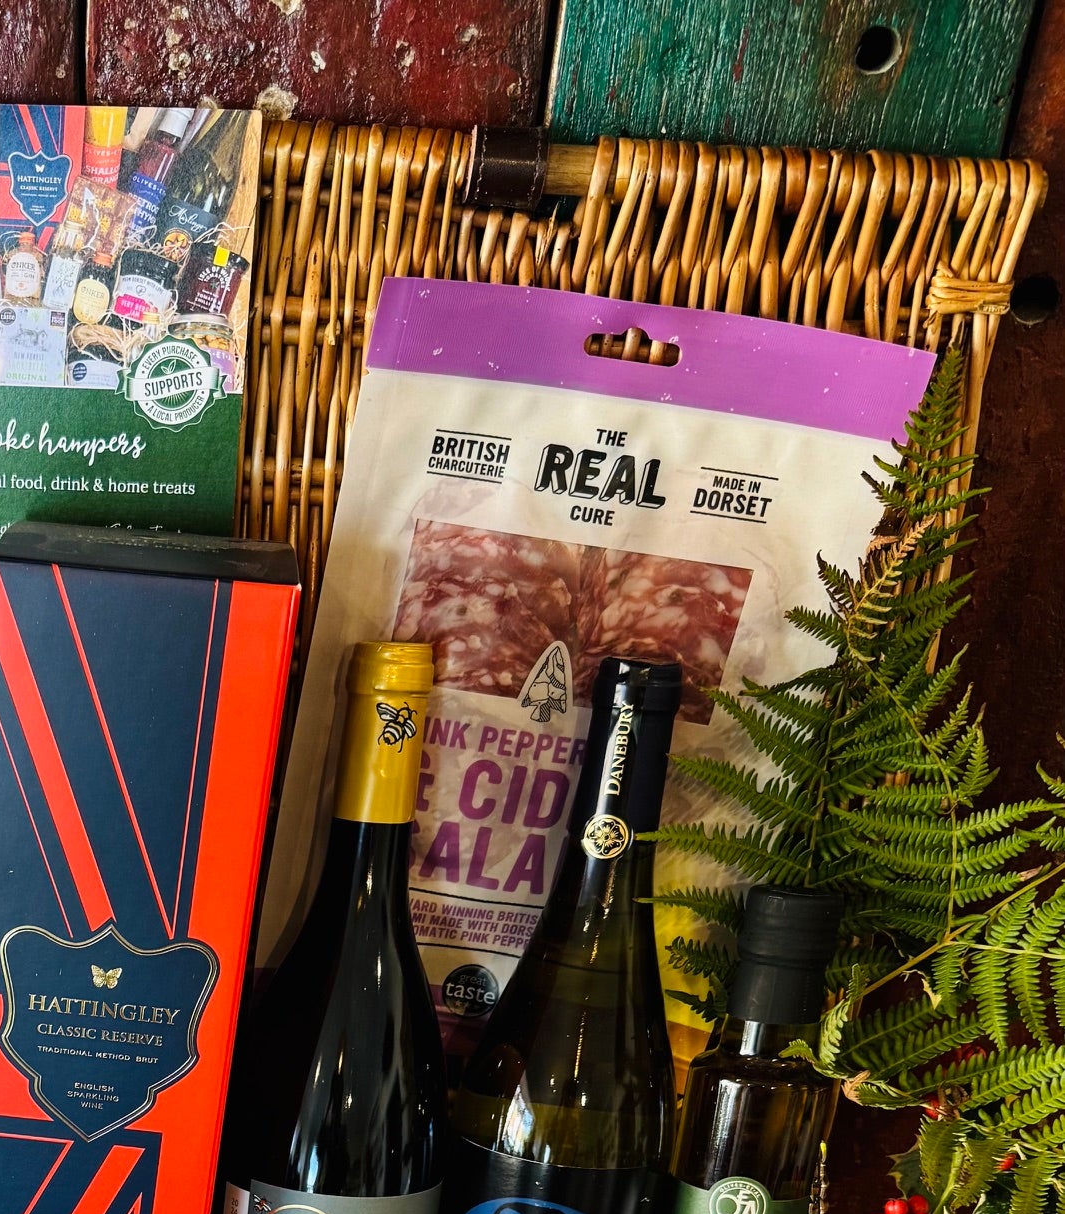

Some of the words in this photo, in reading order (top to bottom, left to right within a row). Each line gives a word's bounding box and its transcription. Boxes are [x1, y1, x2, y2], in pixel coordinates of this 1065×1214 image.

[18, 175, 62, 184] HATTINGLEY
[142, 350, 161, 370] EVERY
[161, 345, 197, 361] PURCHASE
[144, 372, 202, 397] SUPPORTS
[38, 422, 146, 466] hampers
[431, 436, 511, 464] BRITISH
[596, 429, 628, 448] THE
[428, 457, 505, 479] CHARCUTERIE
[534, 443, 666, 510] REAL
[10, 475, 47, 491] food,
[50, 476, 89, 492] drink
[93, 479, 104, 492] &
[108, 480, 149, 494] home
[152, 480, 196, 496] treats
[712, 476, 748, 493] MADE
[750, 480, 761, 493] IN
[693, 488, 772, 518] DORSET
[570, 505, 616, 527] CURE
[478, 726, 585, 766] PEPPER
[603, 700, 634, 796] DANEBURY
[441, 906, 495, 922] WINNING
[445, 981, 496, 1005] taste
[28, 994, 181, 1025] HATTINGLEY
[37, 1023, 96, 1040] CLASSIC
[101, 1030, 163, 1047] RESERVE
[38, 1046, 92, 1057] TRADITIONAL
[96, 1052, 131, 1061] METHOD
[136, 1056, 159, 1064] BRUT
[67, 1090, 119, 1102] SPARKLING
[74, 1082, 114, 1092] ENGLISH
[80, 1101, 104, 1110] WINE
